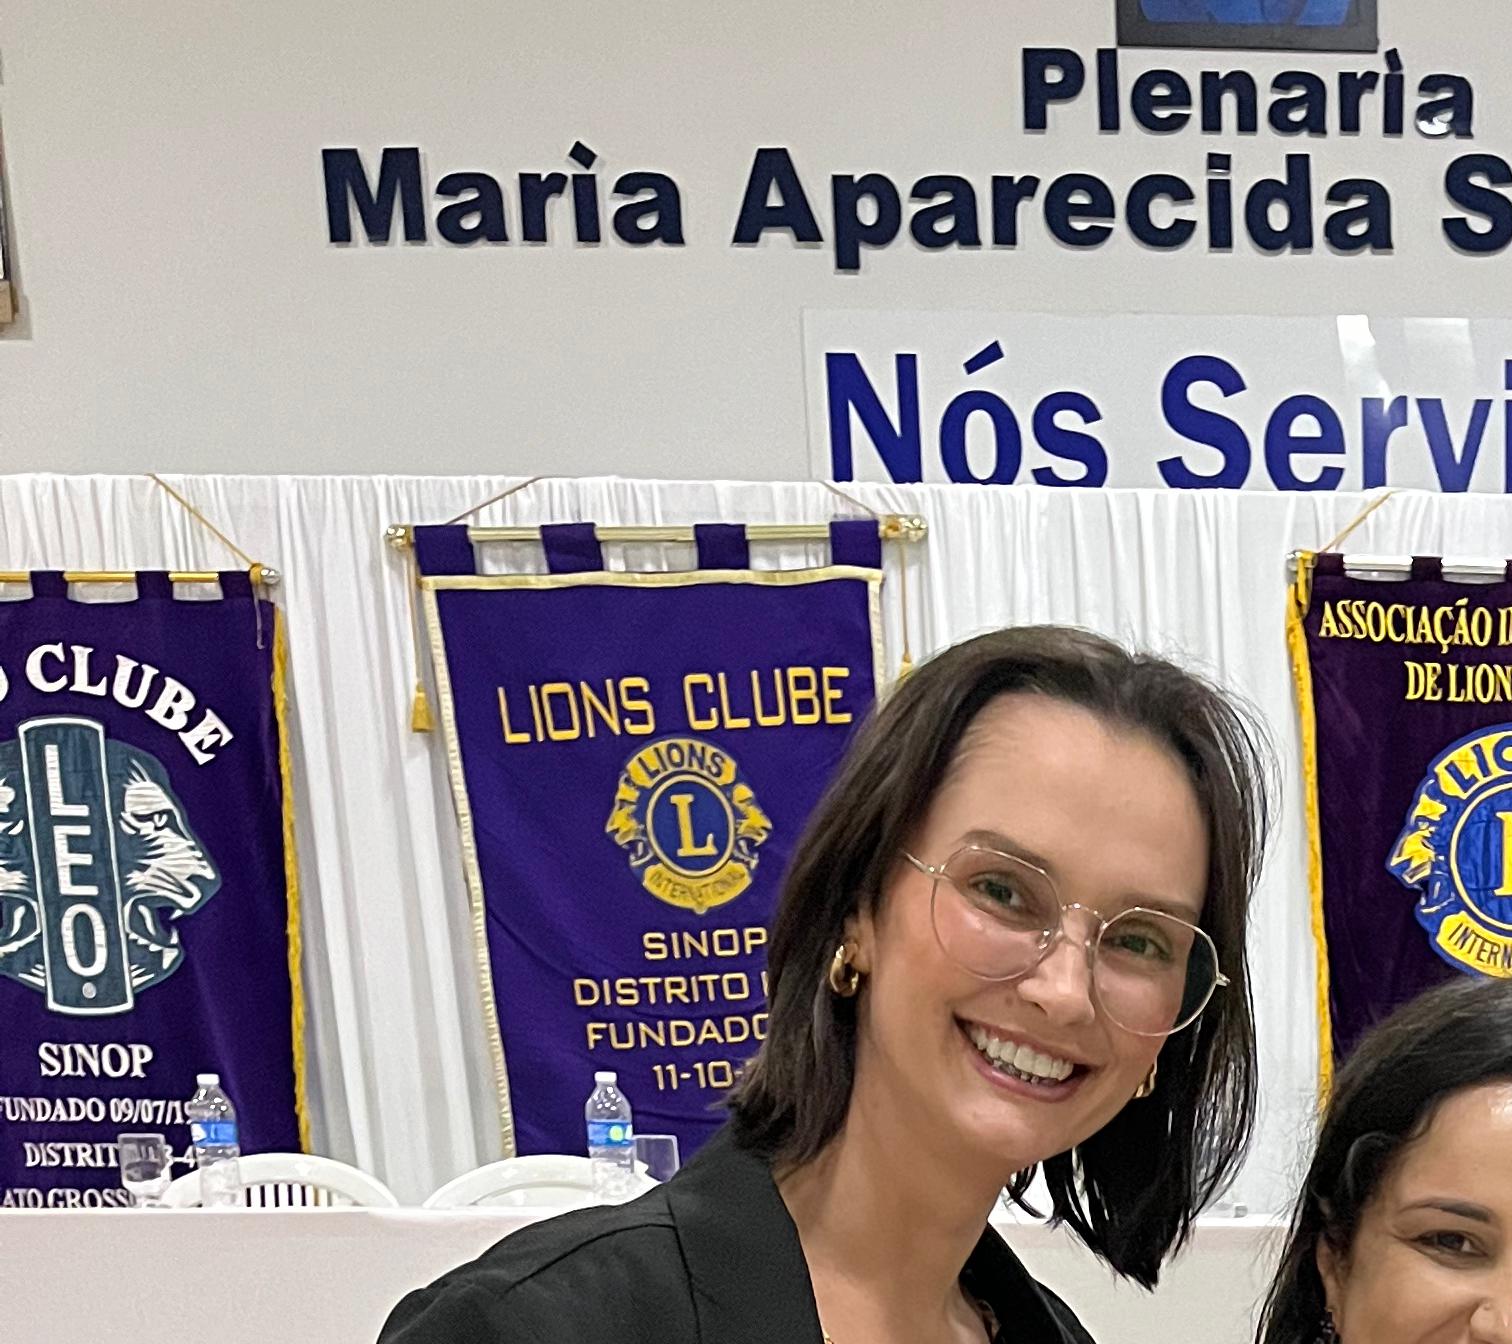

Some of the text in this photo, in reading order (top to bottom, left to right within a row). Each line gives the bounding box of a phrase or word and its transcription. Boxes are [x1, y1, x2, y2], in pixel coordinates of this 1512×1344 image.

[731, 147, 1394, 271] Aparecida
[824, 340, 1109, 488] Nós
[1318, 597, 1492, 654] ASSOCIAÇÃO
[1404, 661, 1442, 701] DE
[25, 642, 234, 765] CLUBE
[497, 666, 852, 744] LIONS CLUBE
[638, 742, 726, 779] LIONS
[669, 794, 719, 857] L
[642, 926, 768, 960] SINOP
[573, 972, 750, 1006] DISTRITO
[38, 1042, 153, 1078] SINOP
[652, 1060, 743, 1091] 11-10-
[23, 1142, 122, 1167] DISTRIT
[2, 1187, 43, 1208] ATO
